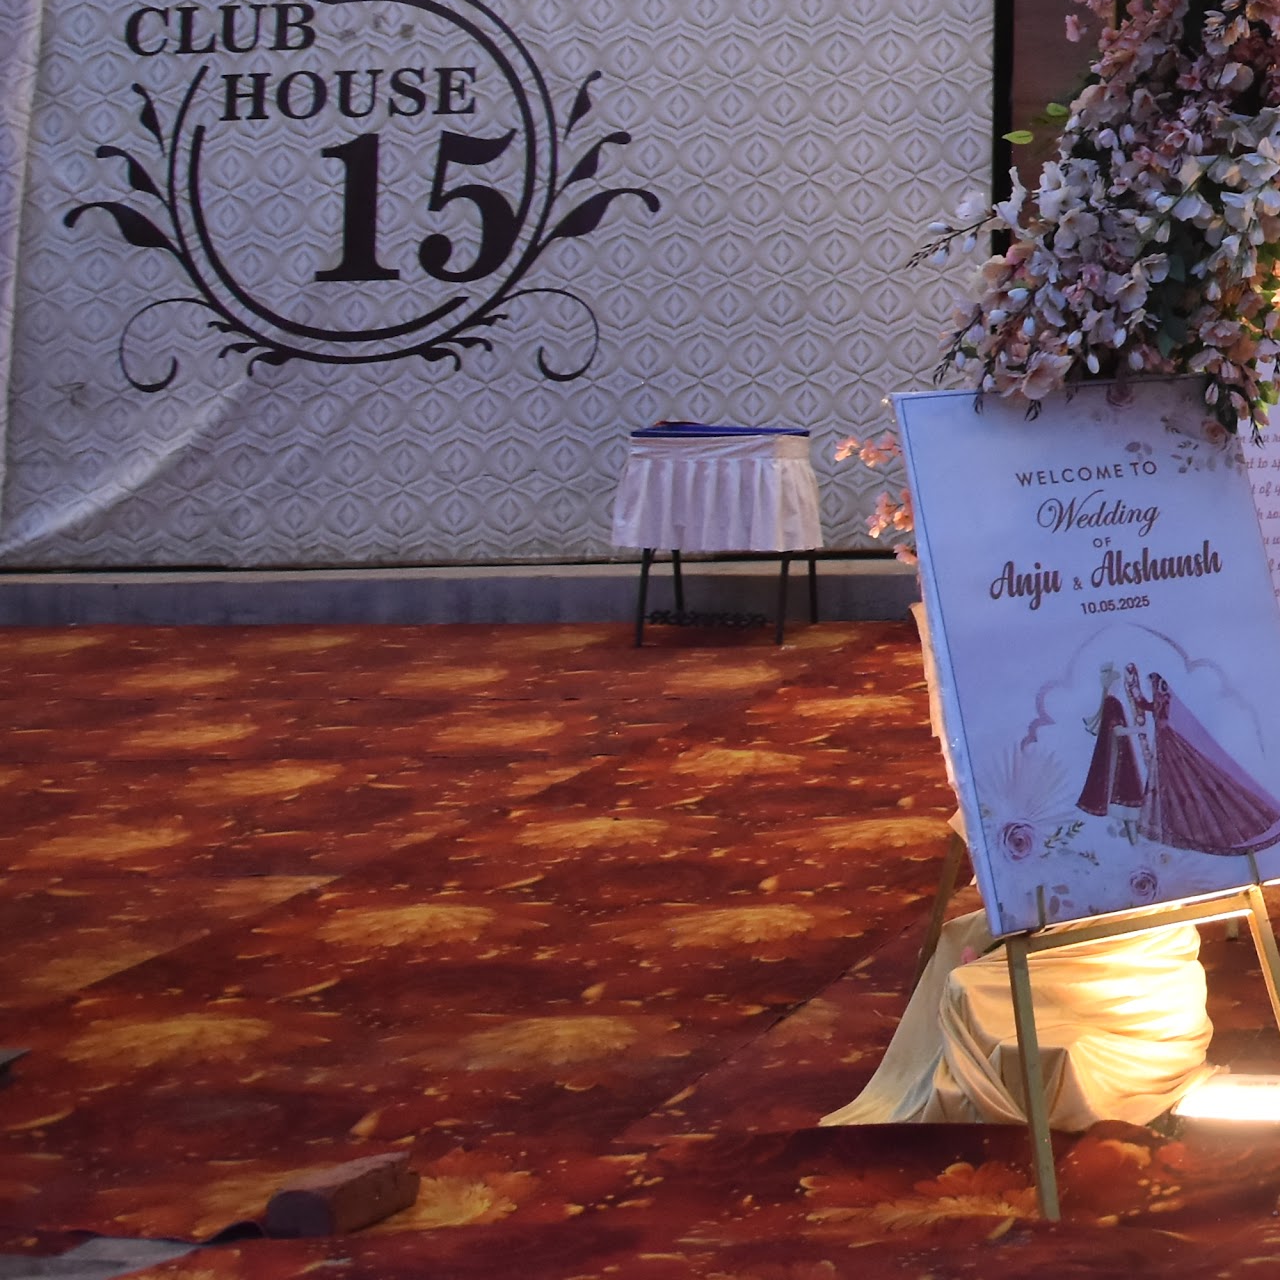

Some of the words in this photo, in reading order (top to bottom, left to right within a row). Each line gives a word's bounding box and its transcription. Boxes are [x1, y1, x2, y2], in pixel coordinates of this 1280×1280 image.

[124, 3, 317, 56] CLUB
[219, 67, 477, 121] HOUSE
[315, 128, 518, 283] 15
[1015, 464, 1123, 487] WELCOME
[1130, 460, 1157, 476] TO
[1257, 456, 1268, 468] to
[1259, 481, 1272, 497] of
[1037, 489, 1160, 537] Wedding
[1093, 537, 1112, 548] OF
[990, 560, 1062, 610] Anju
[1073, 576, 1082, 590] &
[1091, 539, 1223, 588] Akshansh
[1080, 595, 1150, 615] 10.05.2025
